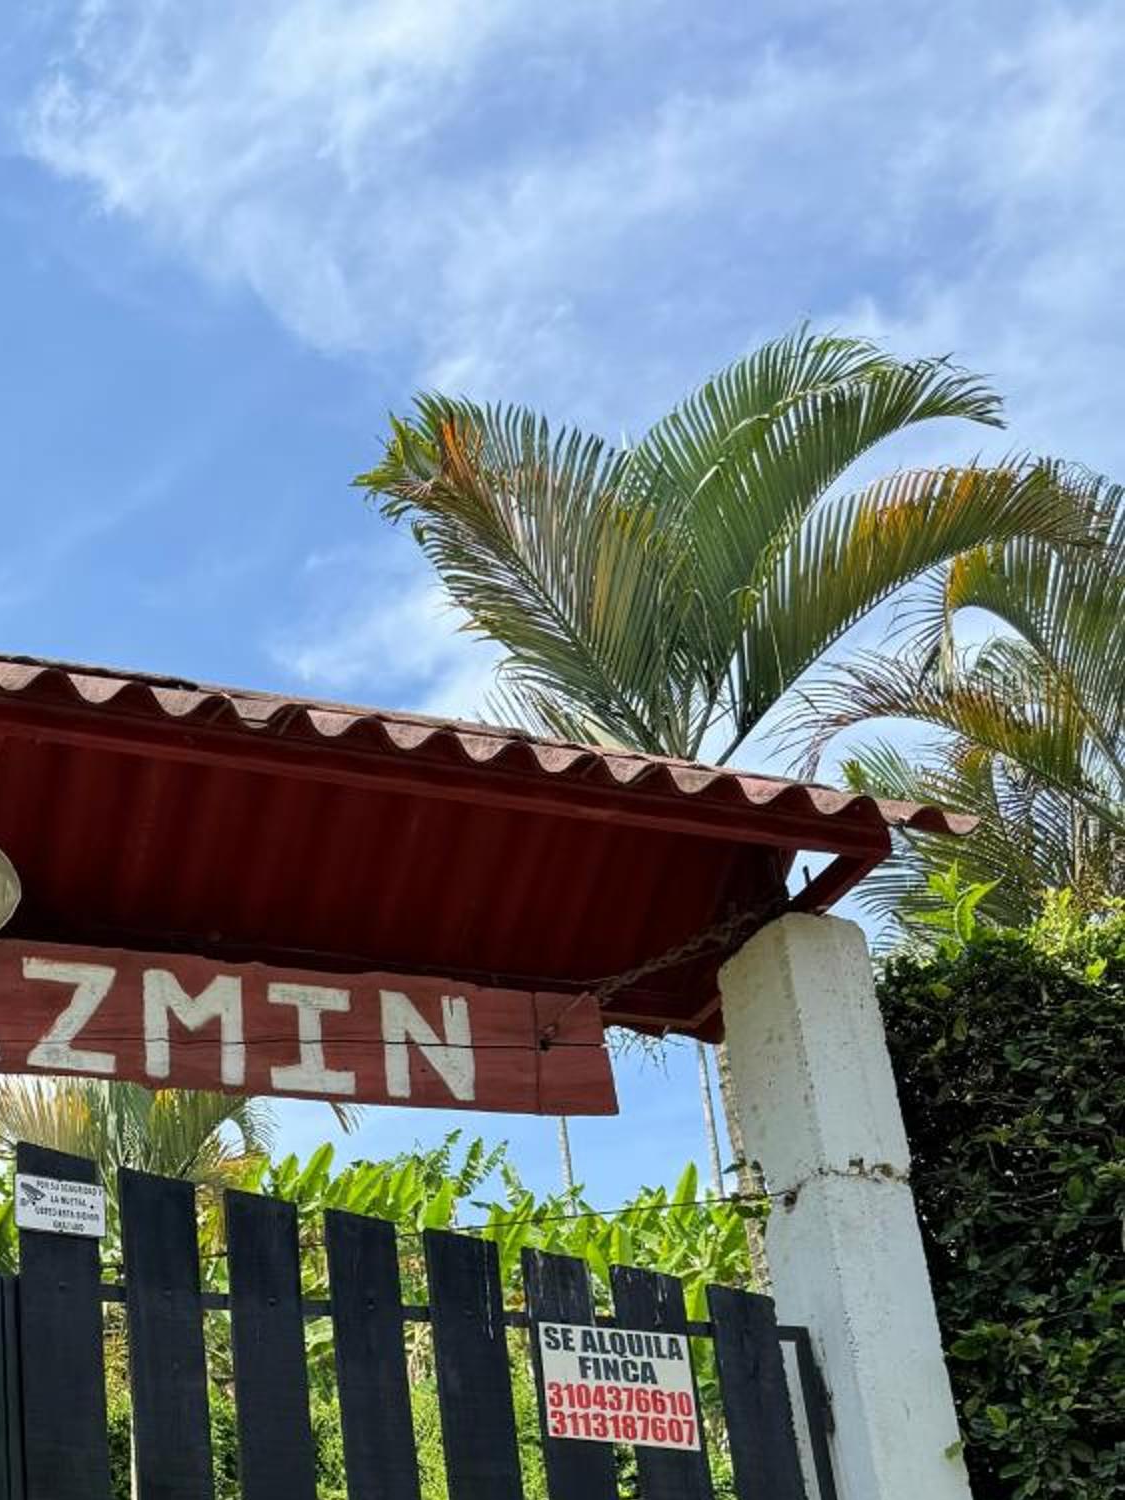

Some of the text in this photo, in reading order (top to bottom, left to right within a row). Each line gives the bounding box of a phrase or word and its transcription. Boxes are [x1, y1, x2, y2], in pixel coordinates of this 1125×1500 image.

[544, 1326, 683, 1361] SE ALQUILA
[578, 1356, 658, 1385] FINCA
[548, 1381, 693, 1417] 3104376610
[550, 1410, 695, 1446] 3113187607
